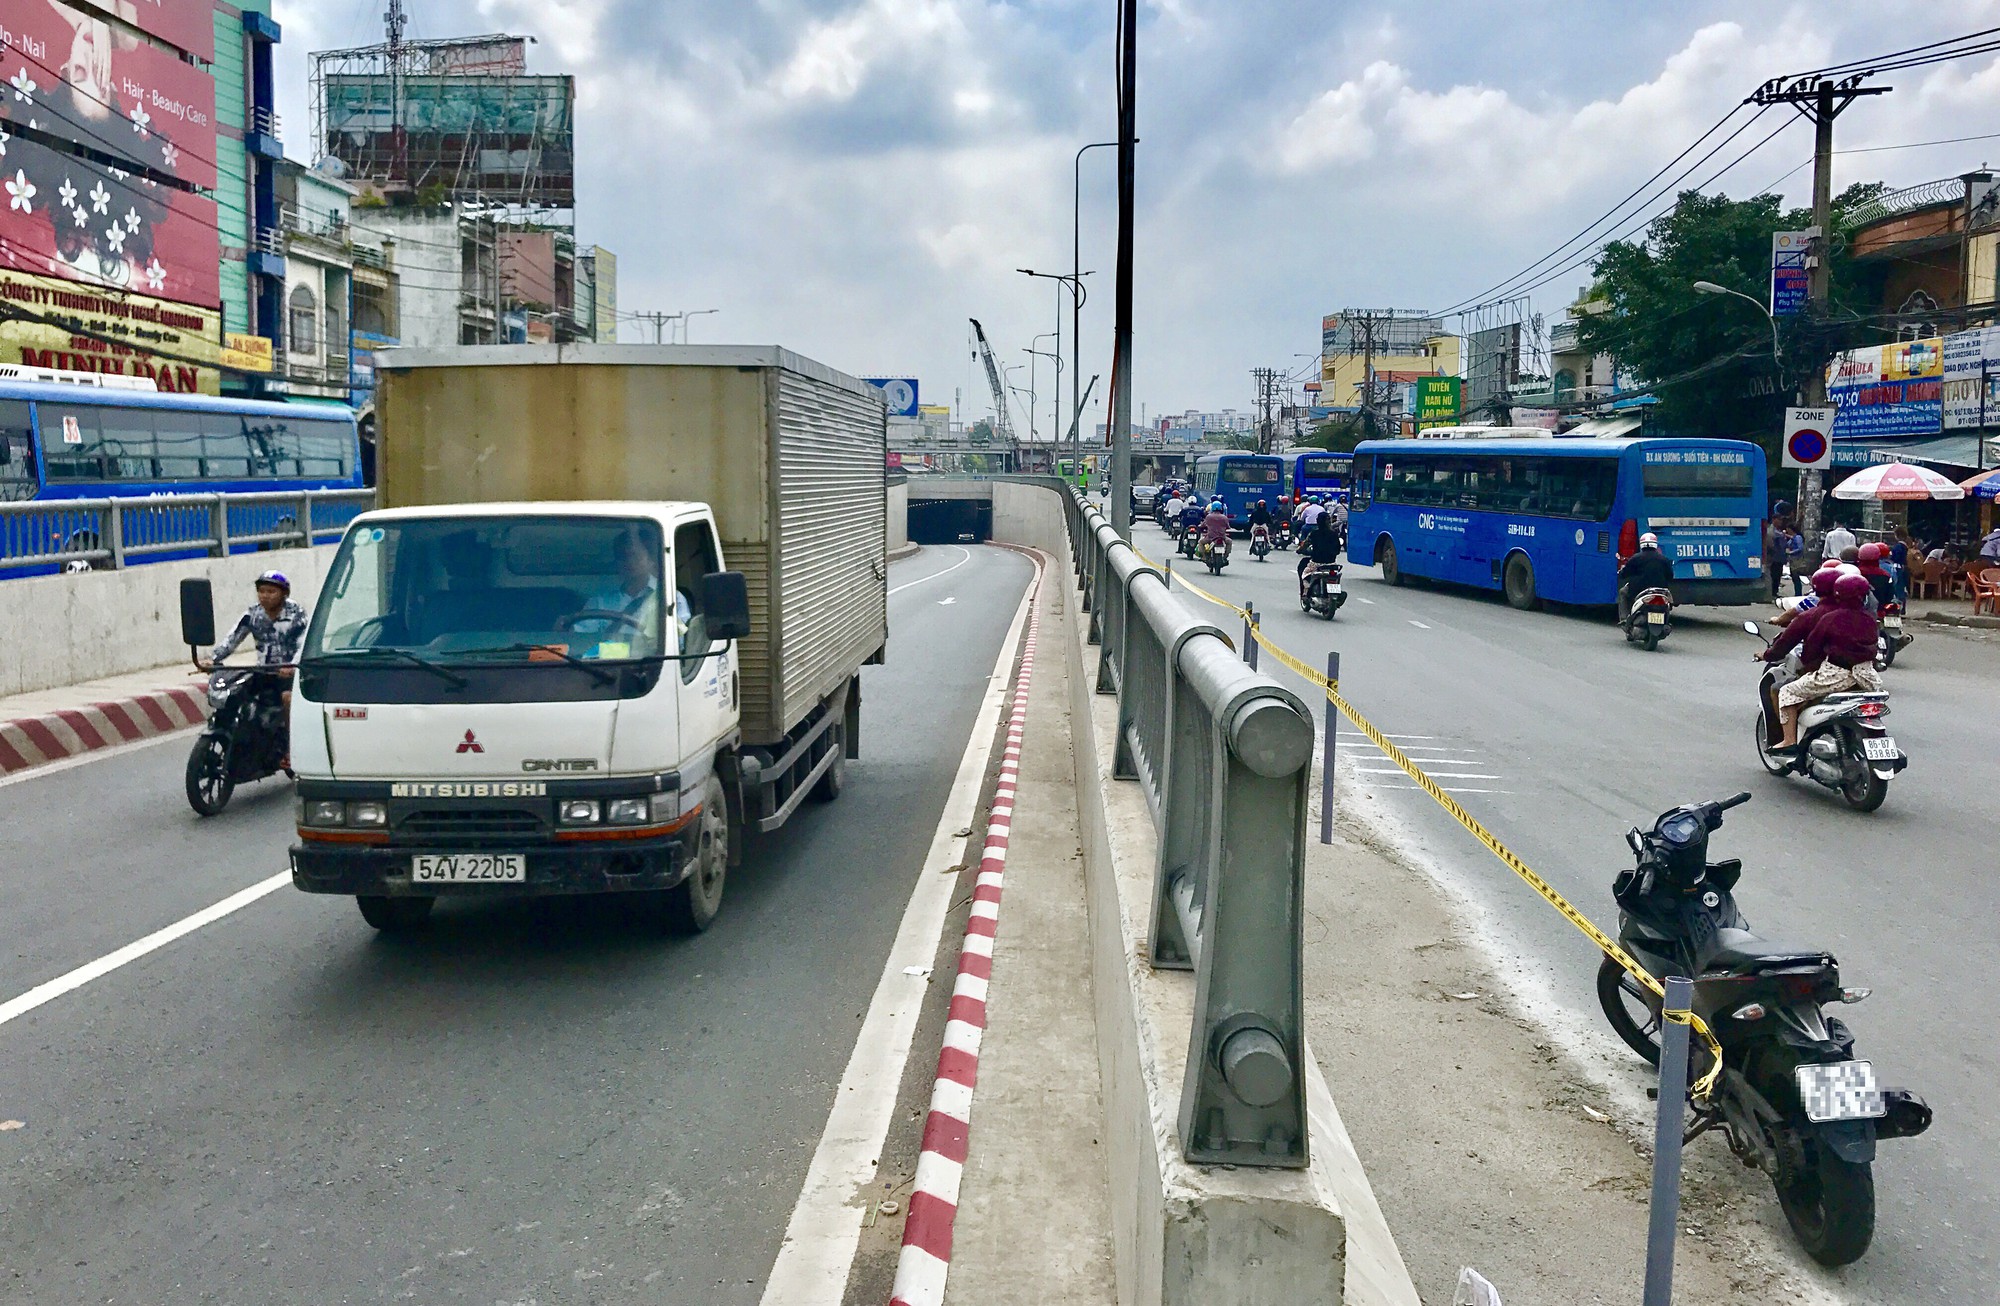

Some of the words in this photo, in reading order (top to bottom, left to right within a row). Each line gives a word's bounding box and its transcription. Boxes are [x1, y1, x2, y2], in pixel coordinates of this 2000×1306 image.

[23, 34, 45, 60] Nail
[123, 77, 144, 101] Hair
[152, 90, 185, 121] Beauty
[187, 105, 207, 127] Care
[1425, 395, 1441, 406] NAM
[1442, 393, 1454, 406] NỮ
[1422, 408, 1435, 419] LAO
[1795, 411, 1825, 421] ZONE
[1646, 452, 1654, 462] BX
[1654, 452, 1662, 462] AN
[1418, 513, 1435, 530] CNG
[1508, 524, 1536, 537] 51B-114.18
[1676, 544, 1731, 557] 51B-114.18
[521, 759, 599, 772] CANTER
[391, 783, 547, 797] MITSUBISHI
[419, 858, 518, 880] 54V-2205
